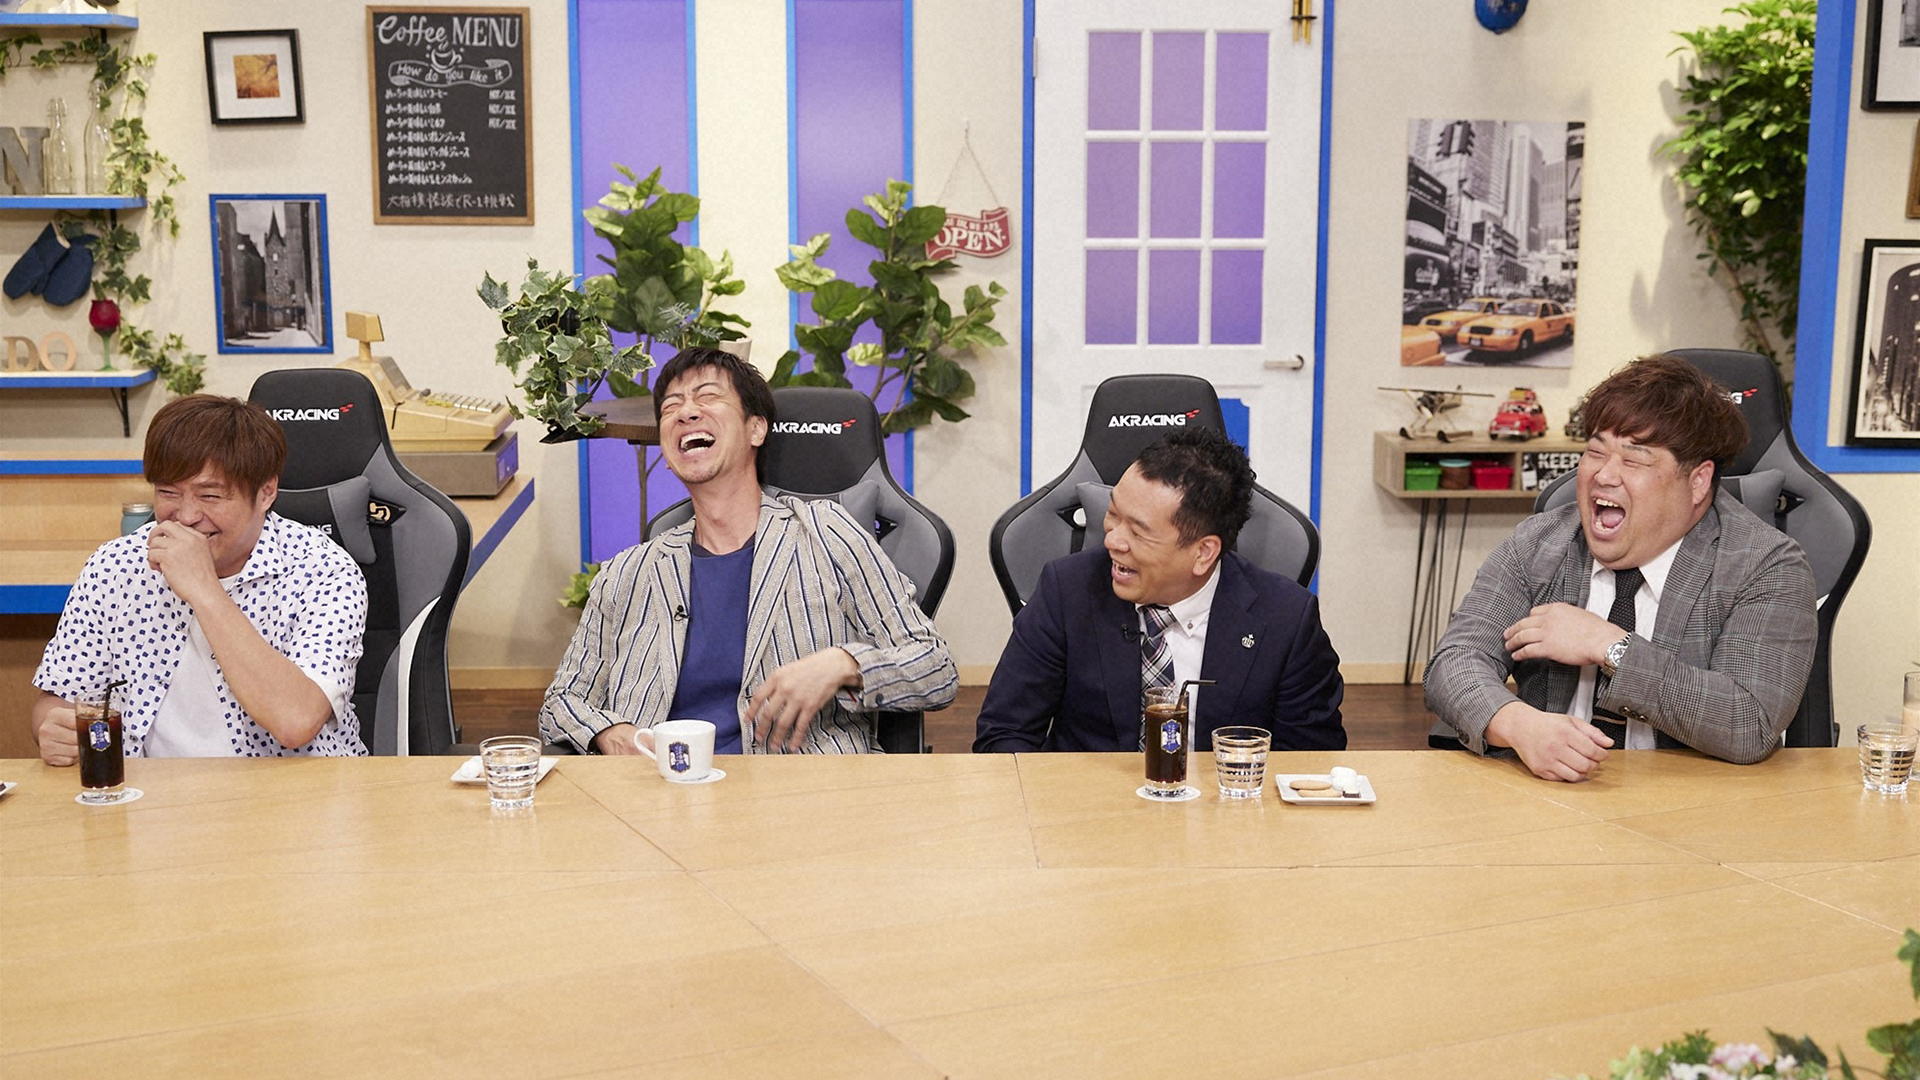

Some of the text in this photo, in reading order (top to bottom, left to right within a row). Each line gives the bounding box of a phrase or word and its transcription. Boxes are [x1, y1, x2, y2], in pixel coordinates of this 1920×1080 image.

[376, 15, 521, 48] Coffee MENU
[397, 63, 504, 85] How do you like it
[1107, 414, 1186, 428] AKRACING
[1538, 452, 1581, 469] KEEP
